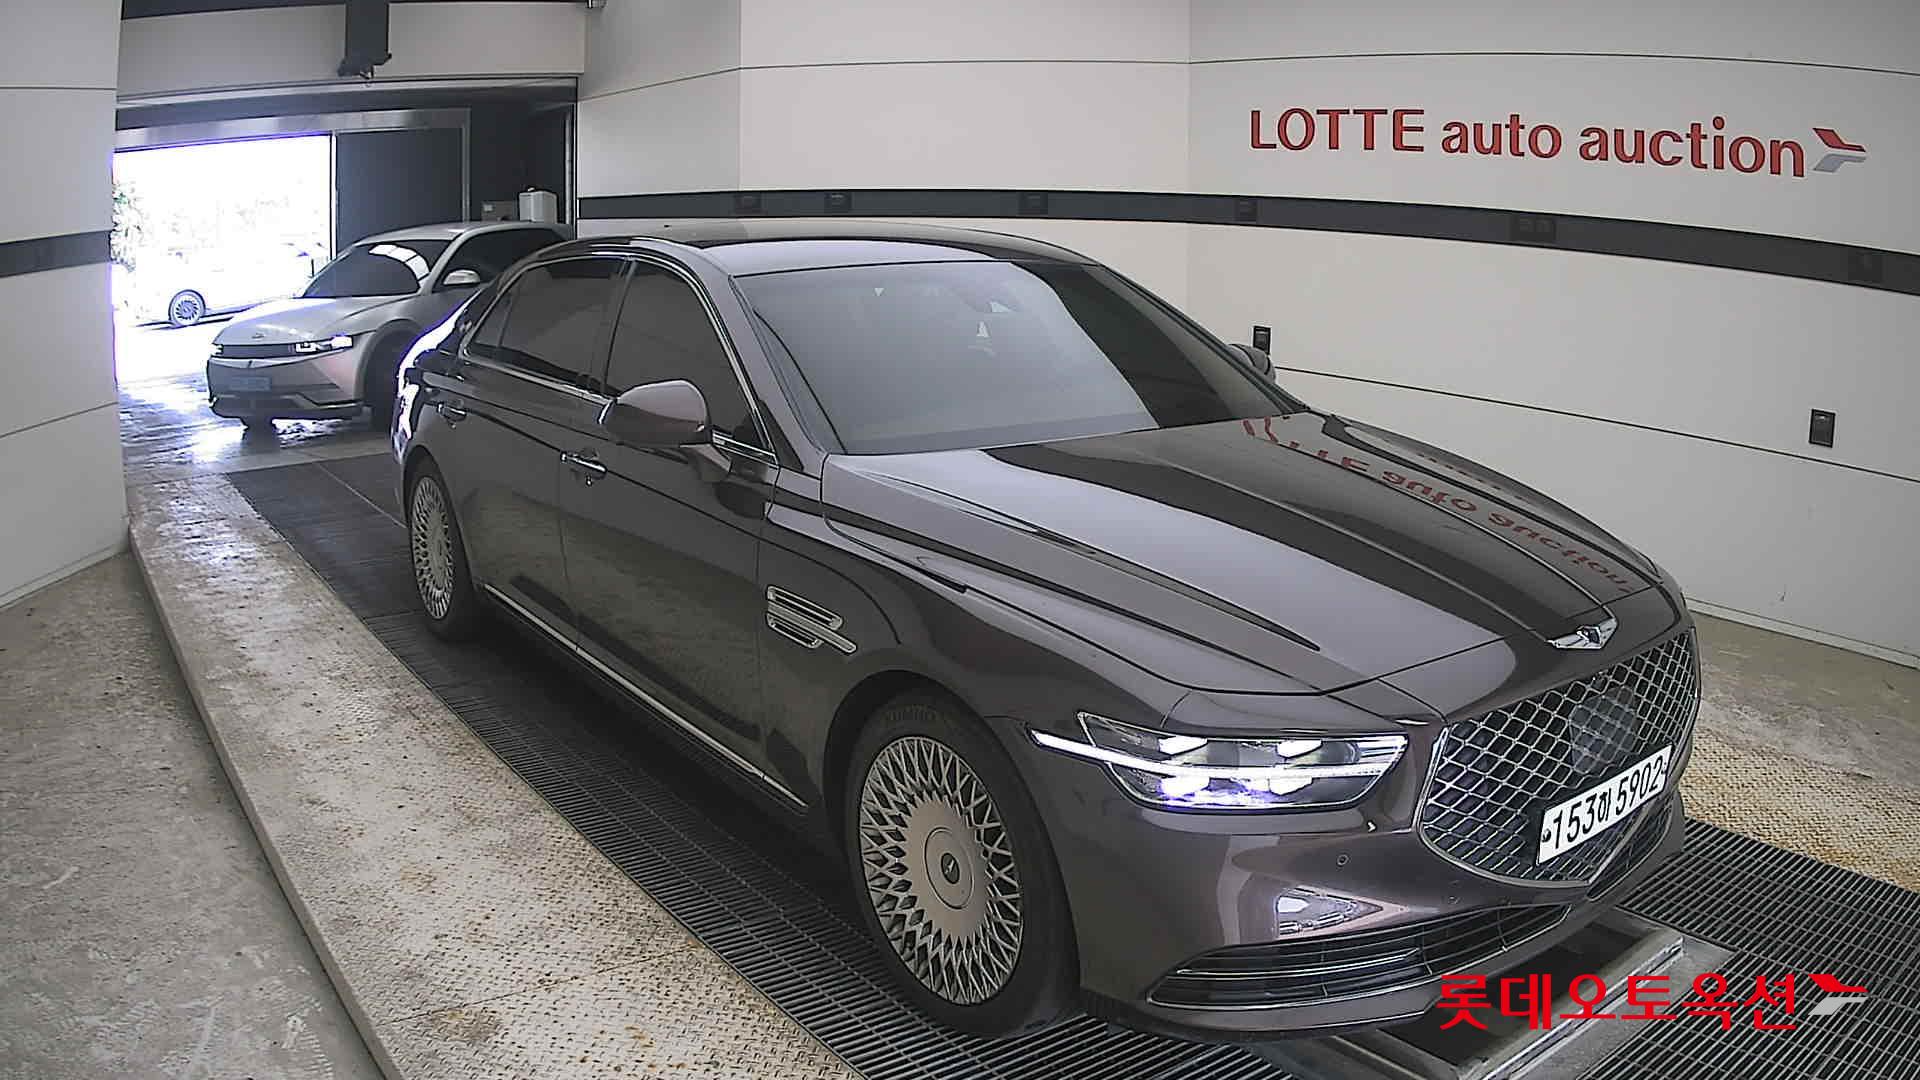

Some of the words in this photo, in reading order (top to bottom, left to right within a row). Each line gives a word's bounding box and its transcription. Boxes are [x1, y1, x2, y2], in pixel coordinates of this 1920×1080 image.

[1250, 107, 1425, 152] LOTTE
[1441, 113, 1562, 158] auto
[1579, 116, 1805, 177] auction
[1615, 754, 1663, 816] 5902
